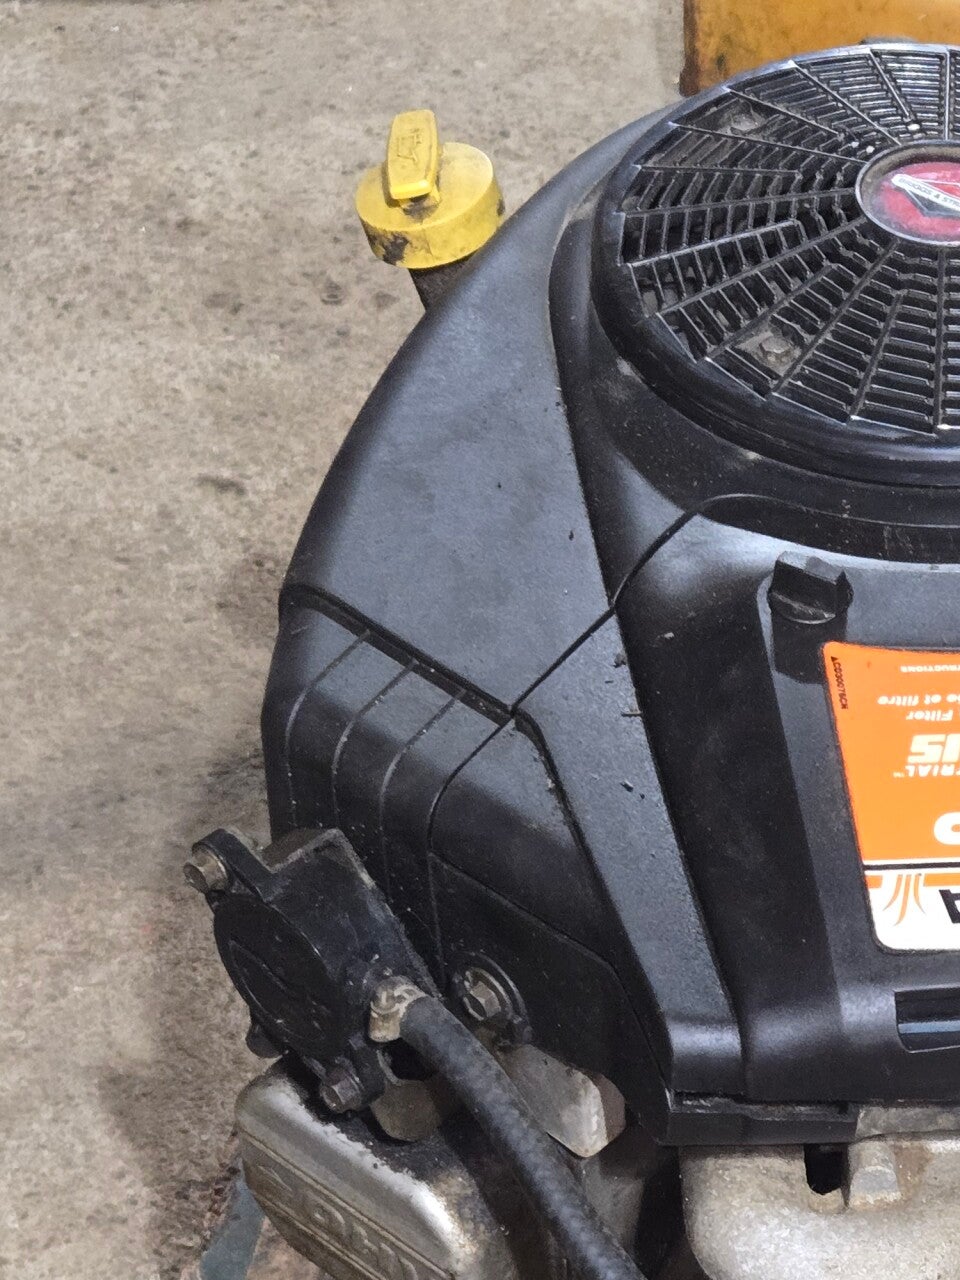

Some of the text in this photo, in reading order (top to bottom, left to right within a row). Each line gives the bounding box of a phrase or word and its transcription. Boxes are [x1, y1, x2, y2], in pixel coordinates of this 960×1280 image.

[877, 694, 919, 707] filtre
[924, 693, 942, 704] et
[906, 709, 953, 722] Filter
